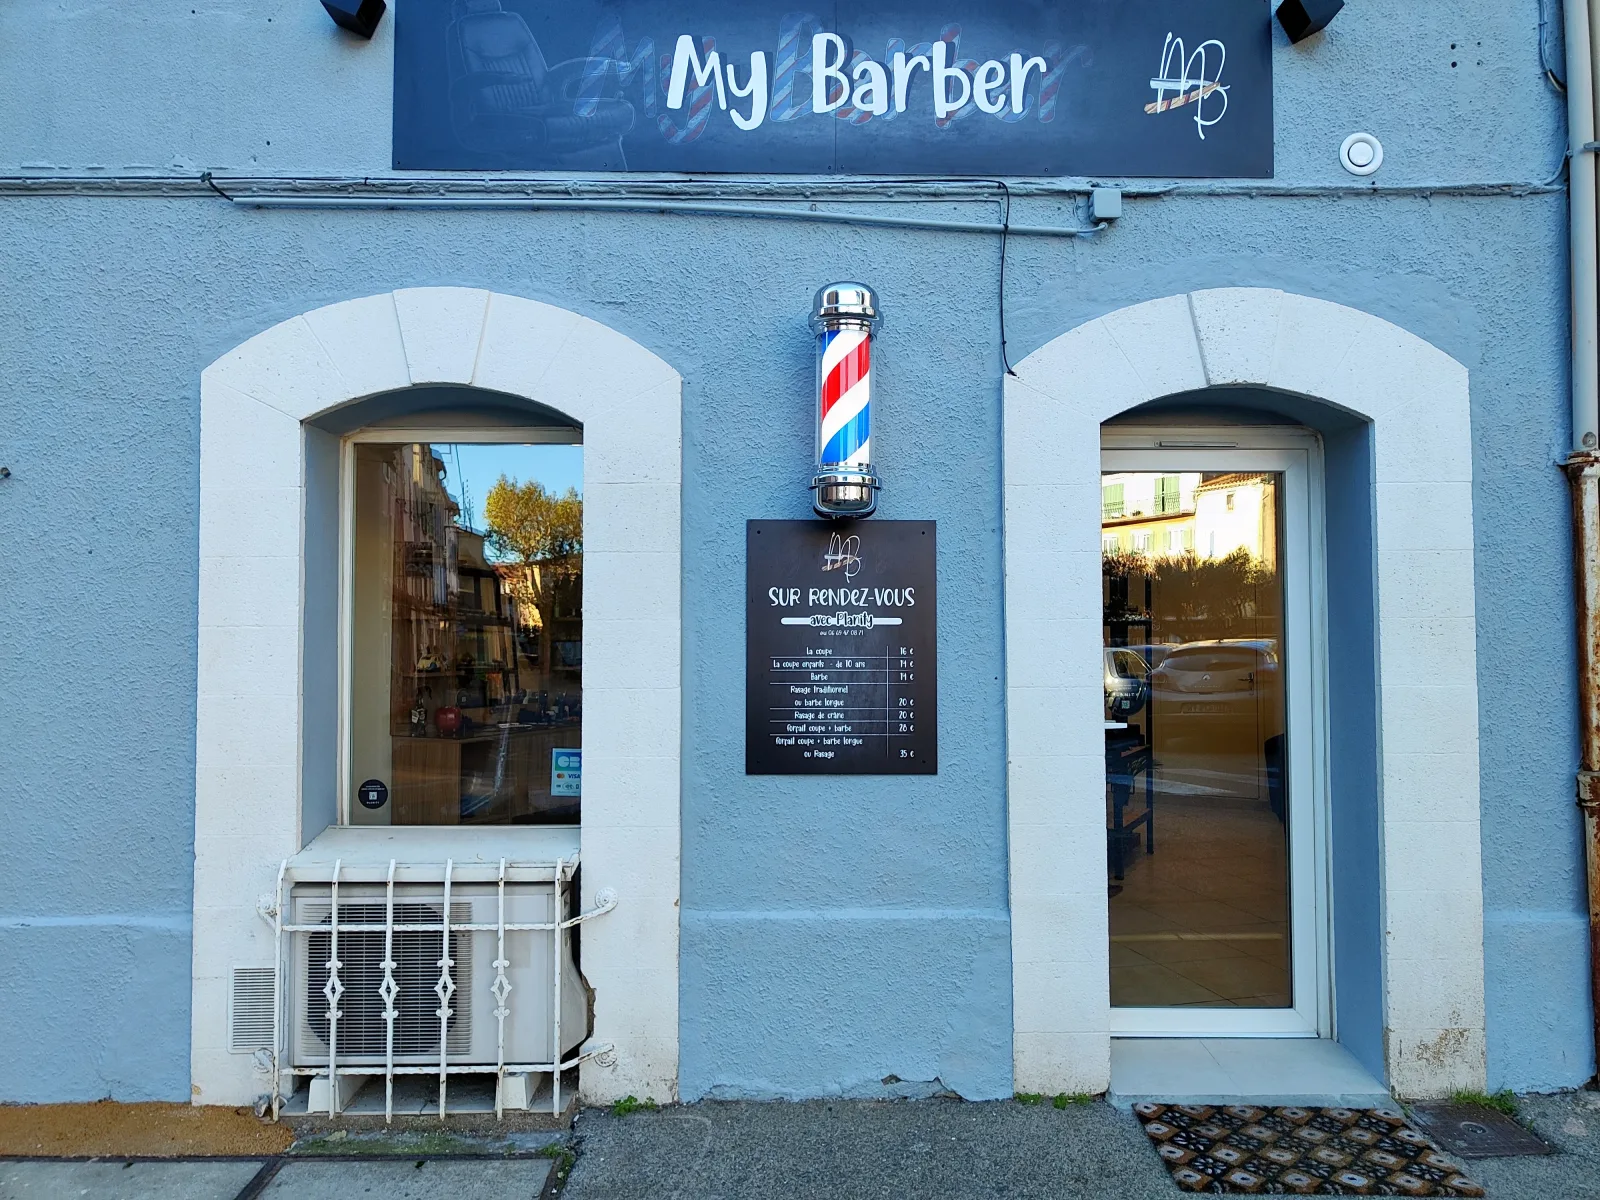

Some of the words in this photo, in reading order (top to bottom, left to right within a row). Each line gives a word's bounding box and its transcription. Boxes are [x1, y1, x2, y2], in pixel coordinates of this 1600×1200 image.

[666, 34, 768, 131] My
[812, 32, 1047, 119] Barber
[768, 586, 801, 607] SUR
[810, 615, 832, 627] avec
[836, 611, 874, 629] Planity
[806, 646, 813, 655] La
[815, 648, 833, 656] coupe
[900, 647, 907, 655] 16
[909, 647, 914, 655] €
[773, 659, 780, 668] La
[782, 661, 800, 669] coupe
[835, 660, 843, 668] de
[845, 659, 853, 668] 10
[909, 660, 914, 668] €
[810, 672, 829, 681] Barbe
[909, 672, 914, 681] €
[790, 685, 811, 695] Rasage
[804, 698, 822, 707] barbe
[824, 697, 845, 707] longue
[898, 697, 907, 707] 20
[909, 698, 914, 706] €
[794, 711, 815, 721] Rasage
[817, 711, 825, 720] de
[898, 710, 907, 719] 20
[909, 711, 914, 719] €
[808, 725, 826, 733] coupe
[834, 723, 852, 732] barbe
[898, 723, 907, 732] 28
[909, 724, 914, 732] €
[797, 738, 815, 746] coupe
[823, 737, 841, 745] barbe
[843, 736, 863, 746] longue
[813, 749, 835, 759] Rasage
[899, 749, 908, 758] 35
[909, 750, 914, 758] €
